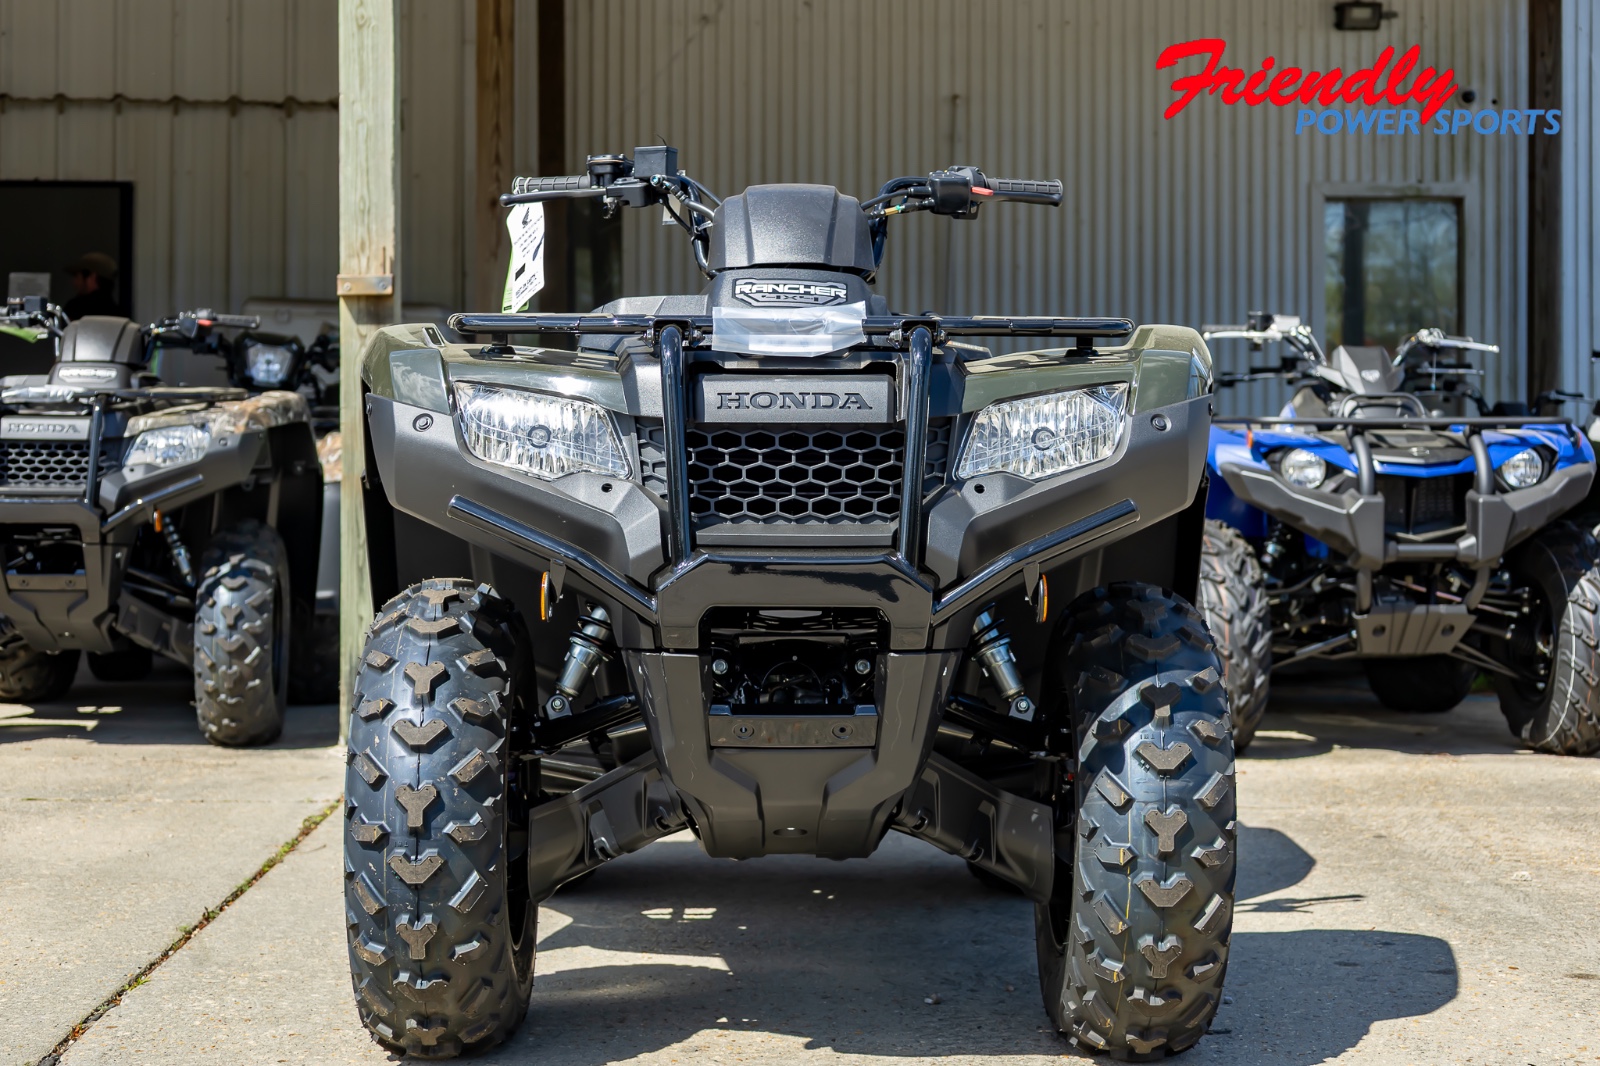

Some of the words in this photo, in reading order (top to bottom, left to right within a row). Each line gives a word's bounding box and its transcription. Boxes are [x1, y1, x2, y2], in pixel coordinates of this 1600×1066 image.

[735, 283, 847, 298] RANCHER
[716, 391, 873, 410] HONDA
[7, 422, 81, 434] HONDA
